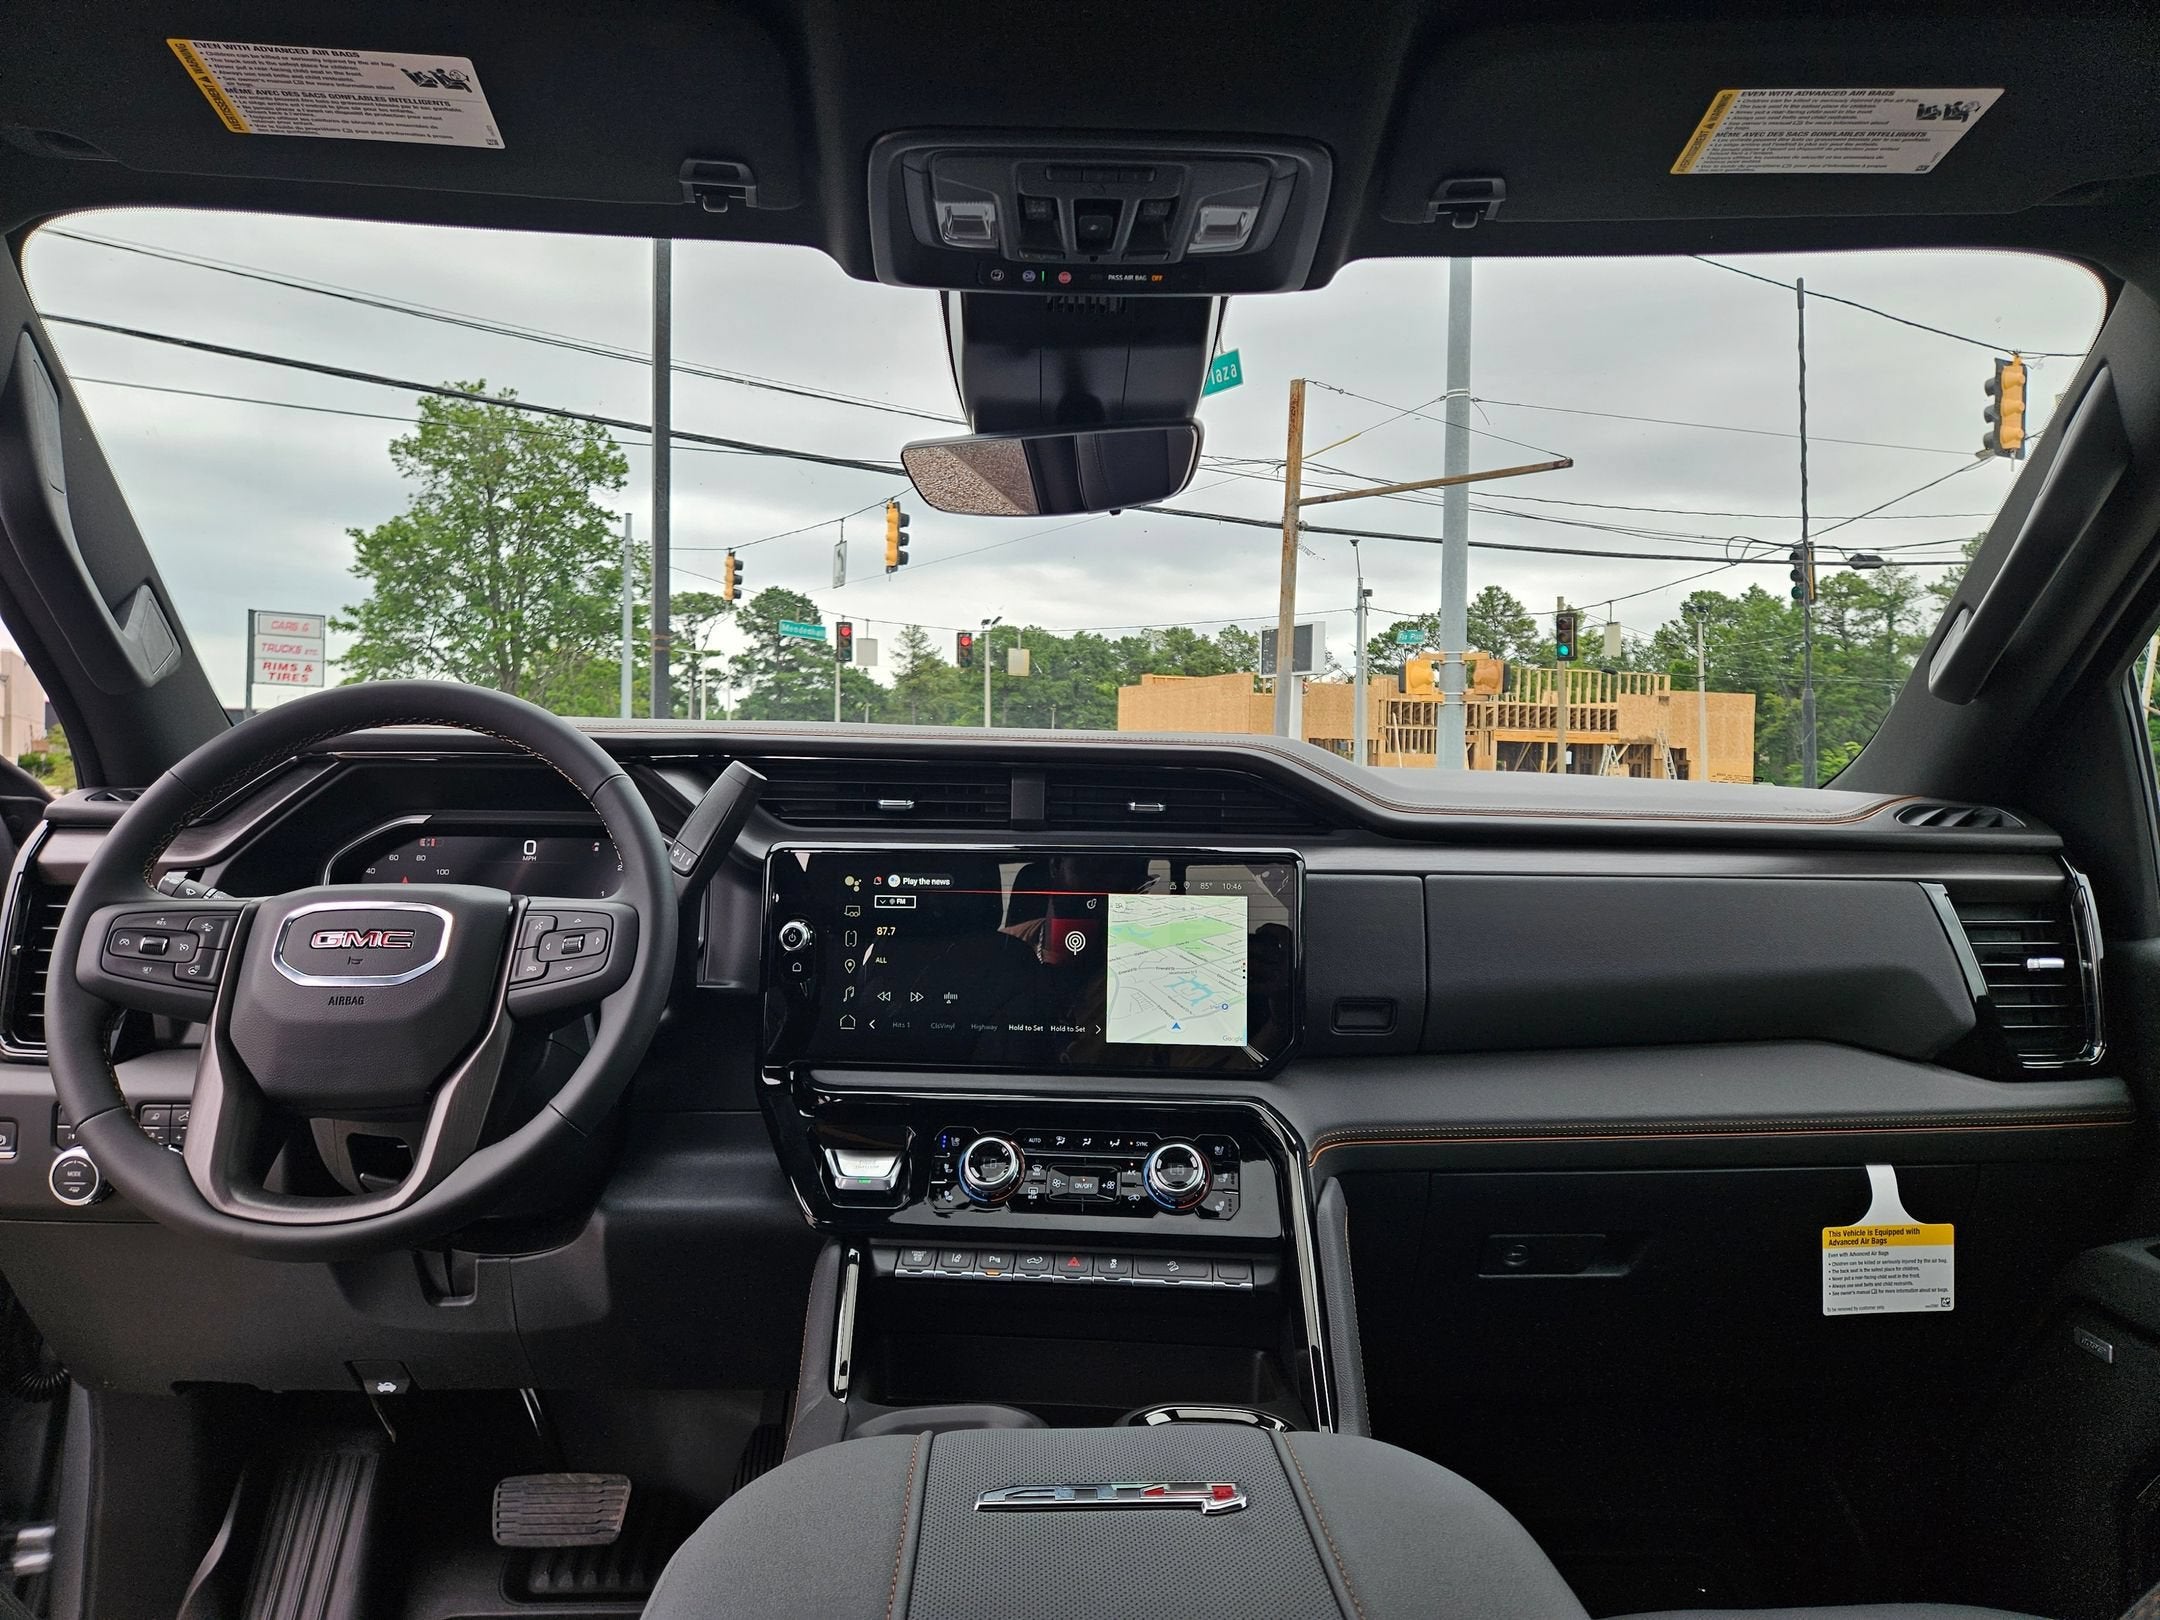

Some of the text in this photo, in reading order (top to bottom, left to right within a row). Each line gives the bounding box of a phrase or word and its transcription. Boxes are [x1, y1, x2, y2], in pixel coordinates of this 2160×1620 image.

[193, 42, 221, 50] EVEN
[223, 43, 250, 51] WITH
[253, 45, 309, 55] ADVANCED
[271, 621, 298, 632] CARS
[262, 643, 303, 655] TRUCKS
[262, 662, 298, 672] RIMS
[269, 672, 309, 682] TIRES
[523, 839, 537, 856] 0
[365, 867, 376, 875] 40
[902, 877, 918, 887] Play
[919, 877, 931, 885] the
[1222, 882, 1242, 891] 10:46
[876, 926, 896, 936] 87.7
[310, 930, 415, 950] GMC
[875, 956, 887, 964] ALL
[328, 996, 365, 1006] AIRBAG
[971, 1023, 998, 1032] Highway
[1033, 1024, 1044, 1032] Set
[1075, 1025, 1086, 1033] Set
[1829, 1230, 1842, 1238] This
[1843, 1229, 1866, 1237] Vehicle
[1874, 1228, 1904, 1237] Equipped
[1905, 1227, 1920, 1235] with
[1828, 1238, 1859, 1246] Advanced
[1871, 1237, 1888, 1246] Bags
